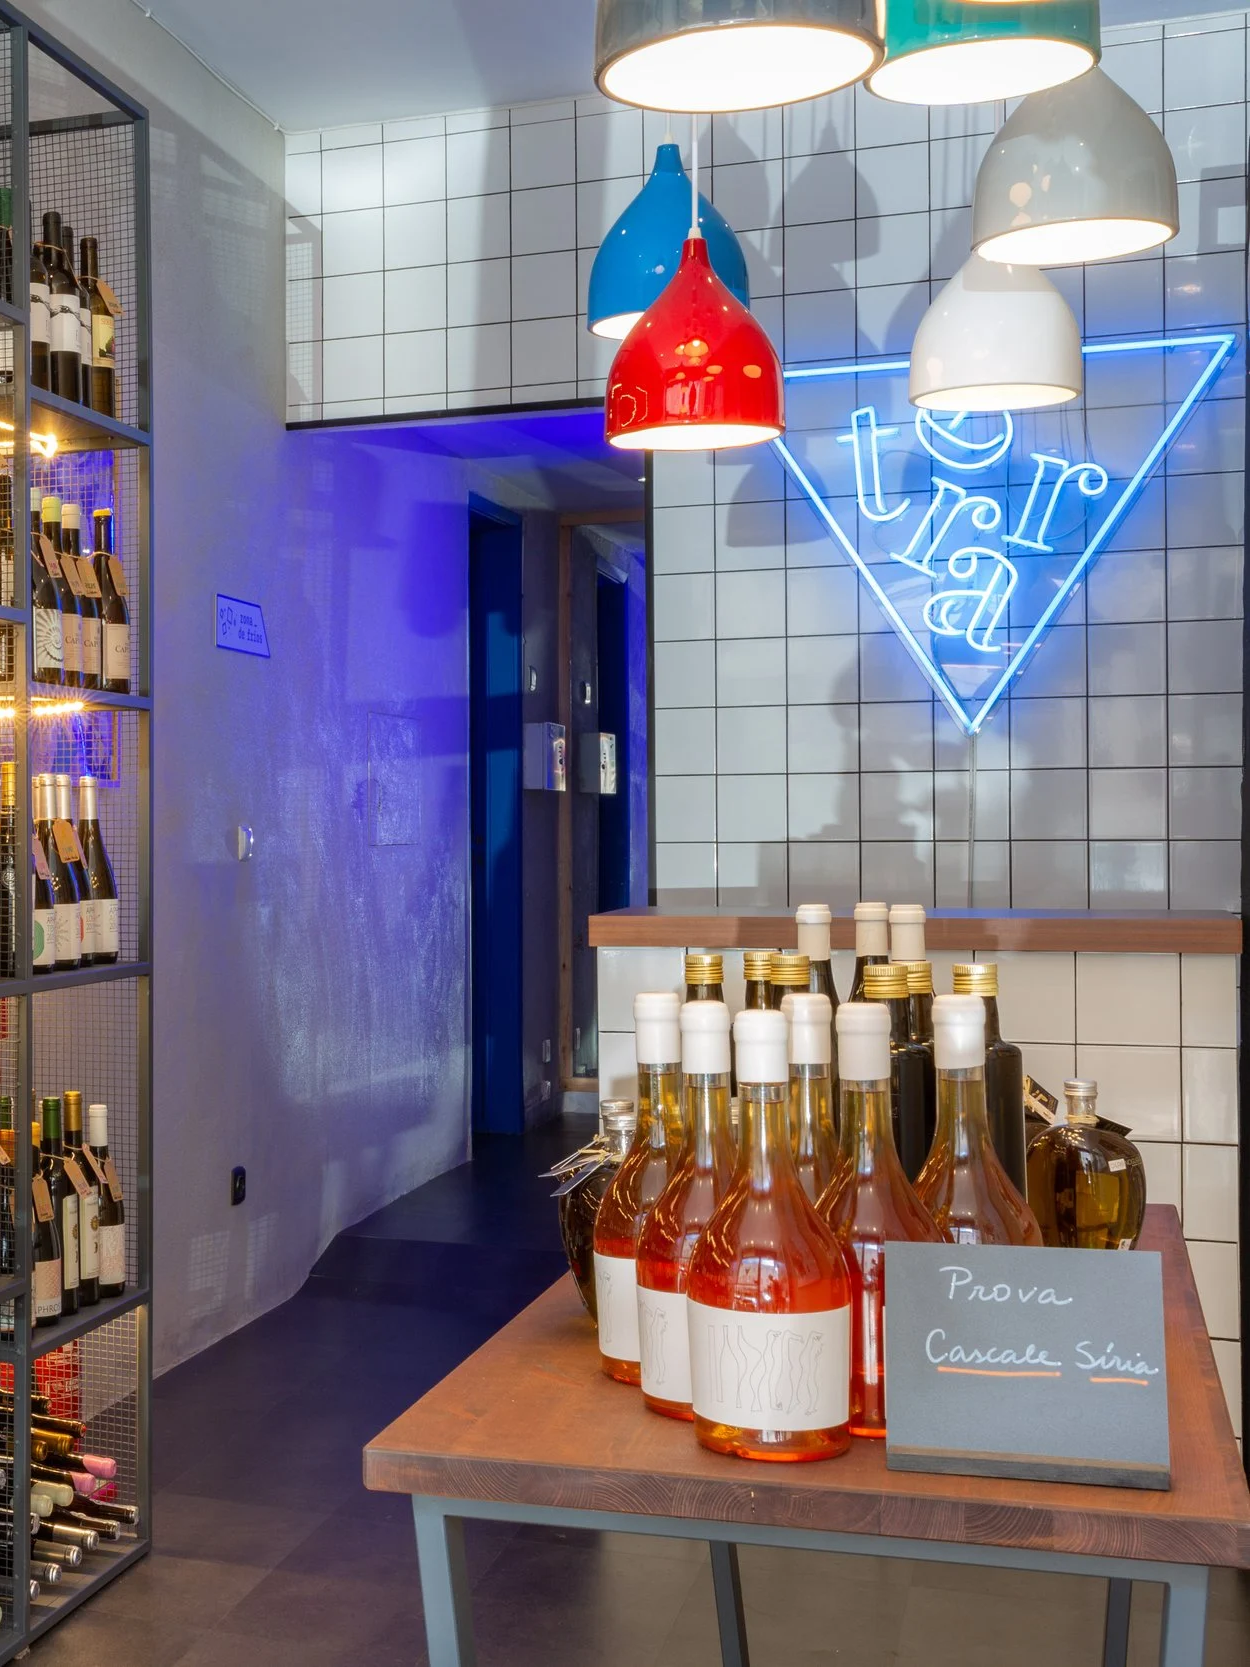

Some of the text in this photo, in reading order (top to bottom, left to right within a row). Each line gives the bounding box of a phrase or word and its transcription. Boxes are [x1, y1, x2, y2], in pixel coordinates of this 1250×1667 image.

[35, 1301, 61, 1314] PHROS
[937, 1264, 1074, 1308] Prova
[924, 1328, 1160, 1378] Cascale Síria
